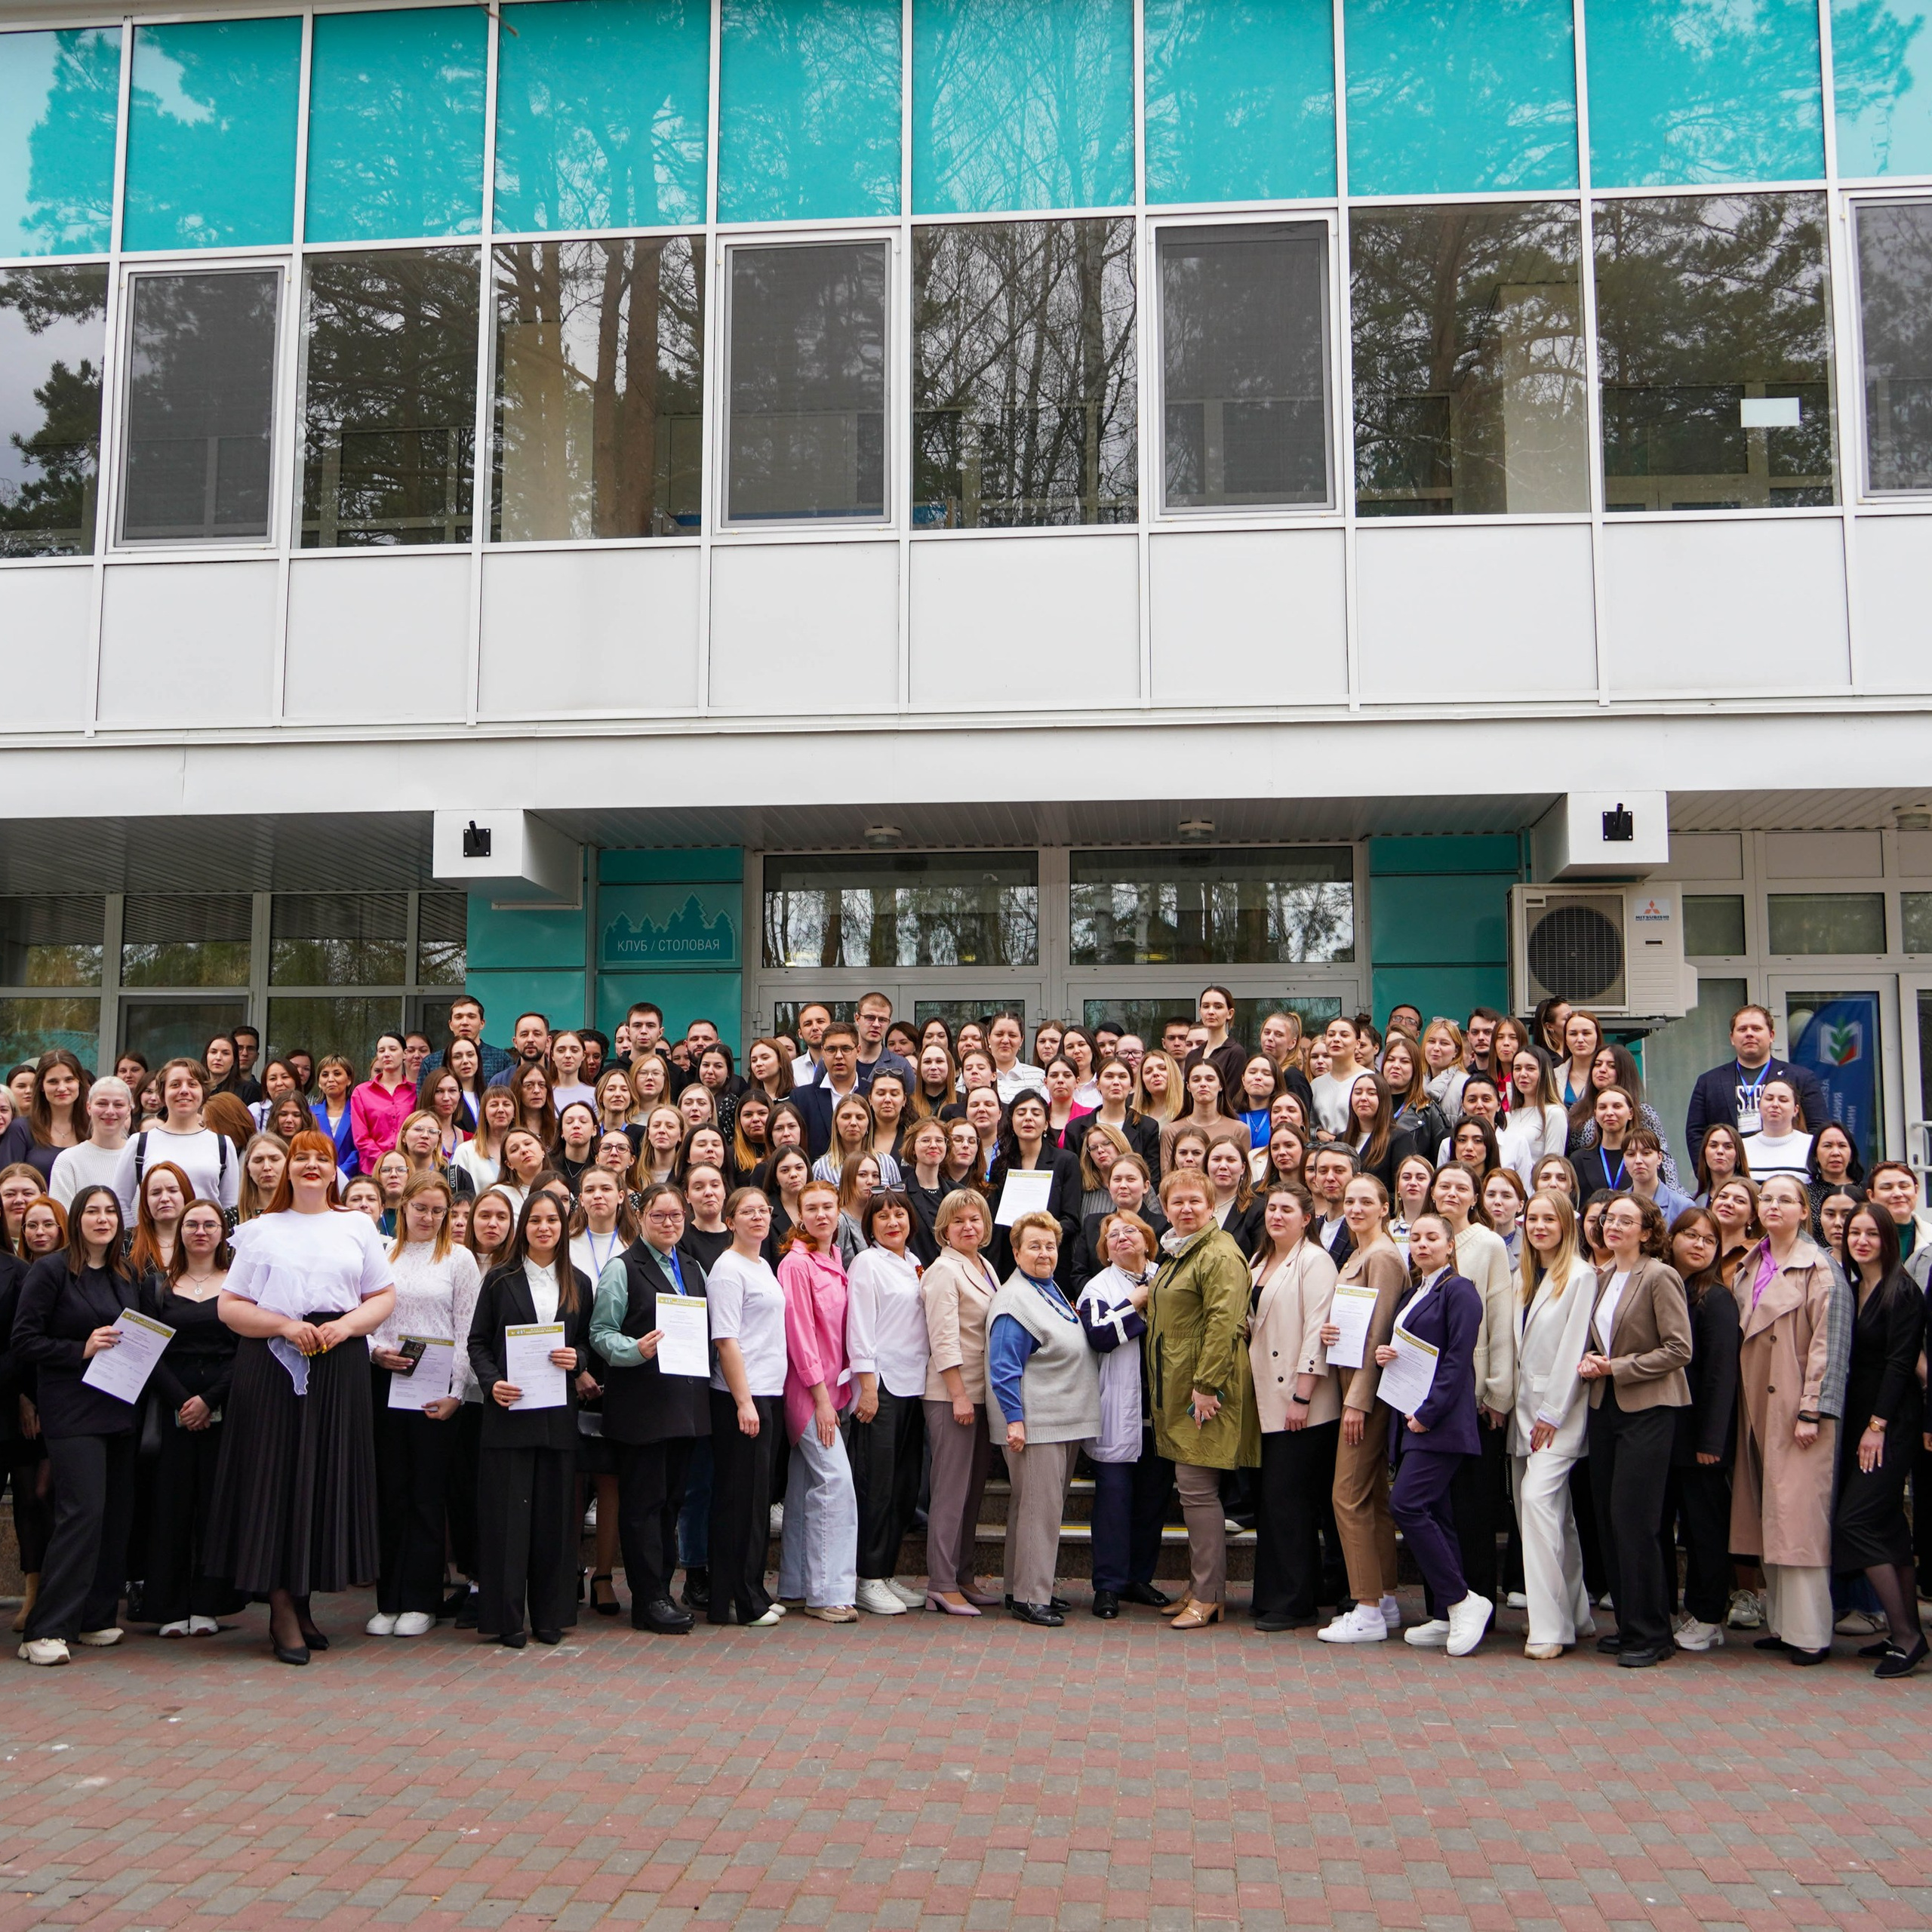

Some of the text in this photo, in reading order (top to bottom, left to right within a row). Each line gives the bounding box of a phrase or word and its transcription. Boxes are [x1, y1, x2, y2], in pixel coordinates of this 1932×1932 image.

[617, 939, 719, 952] КЛУБ / СТОЛОВАЯ
